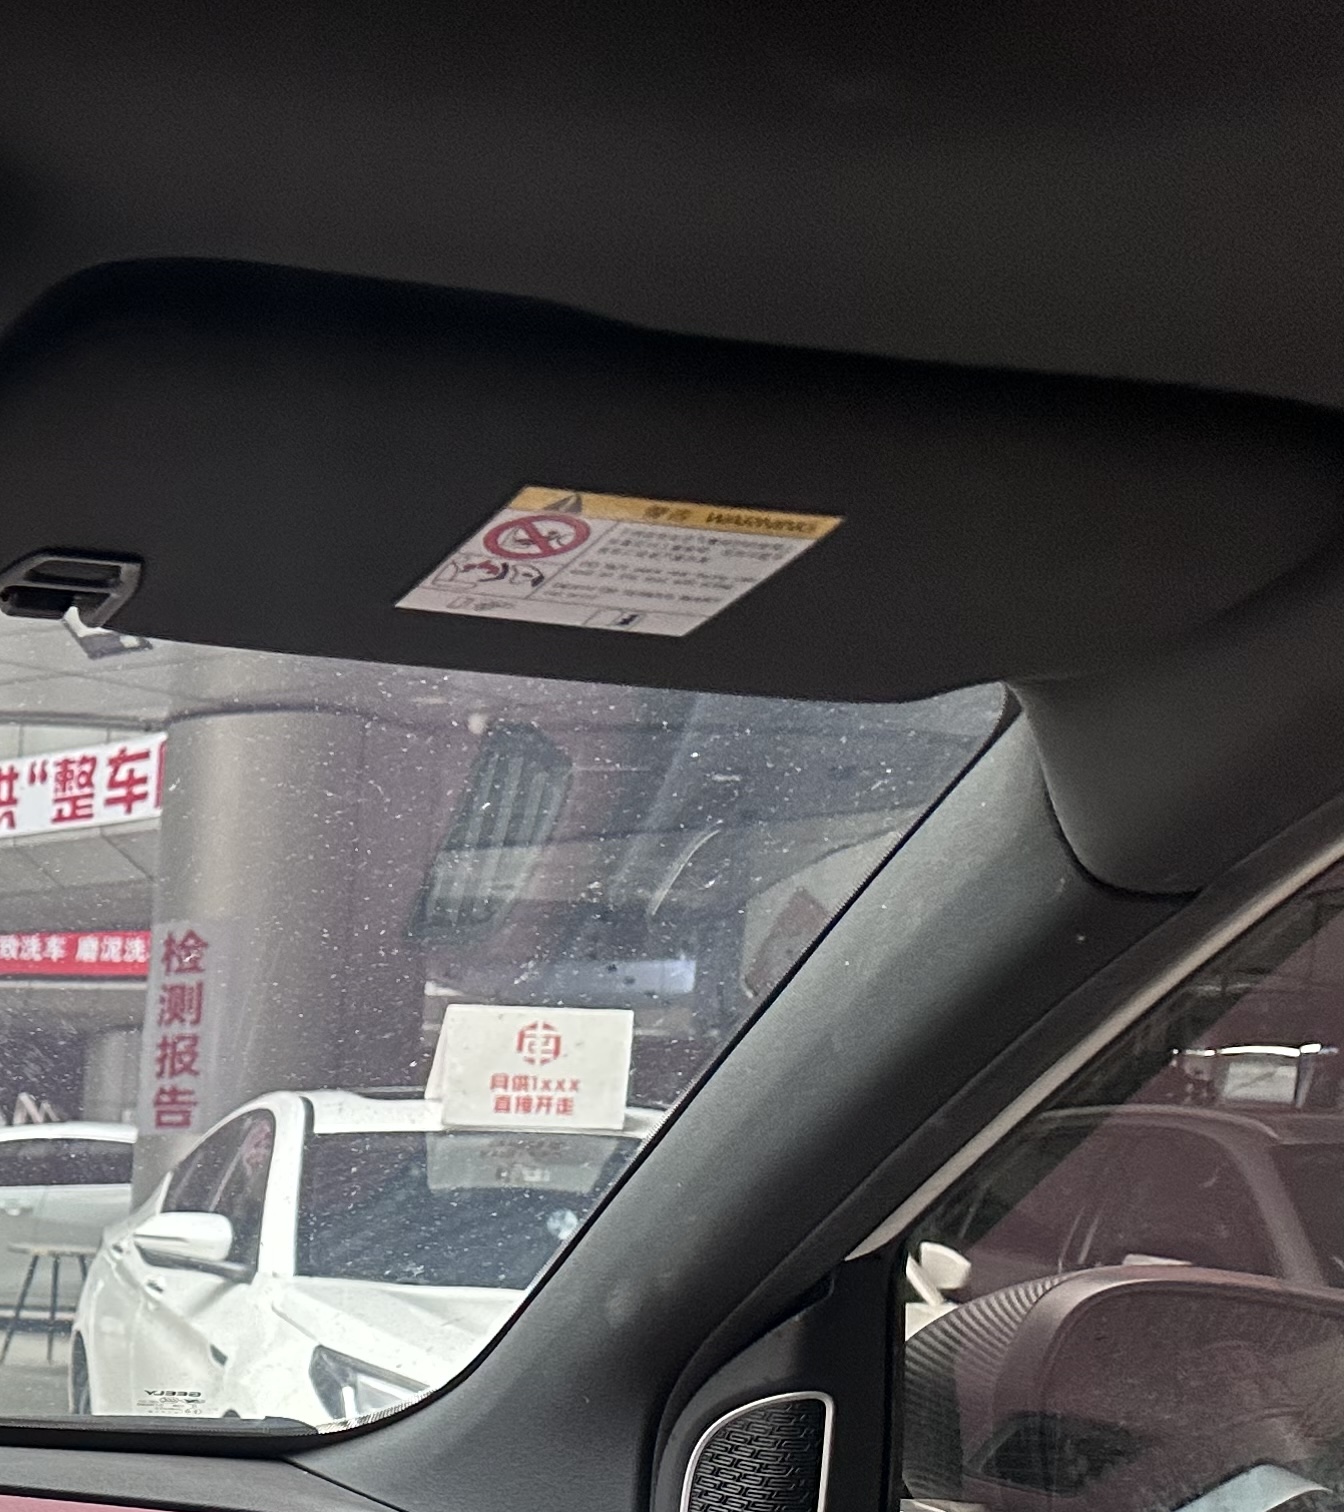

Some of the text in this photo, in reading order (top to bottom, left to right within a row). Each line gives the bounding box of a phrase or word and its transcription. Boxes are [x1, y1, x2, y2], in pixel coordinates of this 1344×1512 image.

[153, 930, 209, 1129] 检测报告
[494, 1095, 574, 1115] 直接开走
